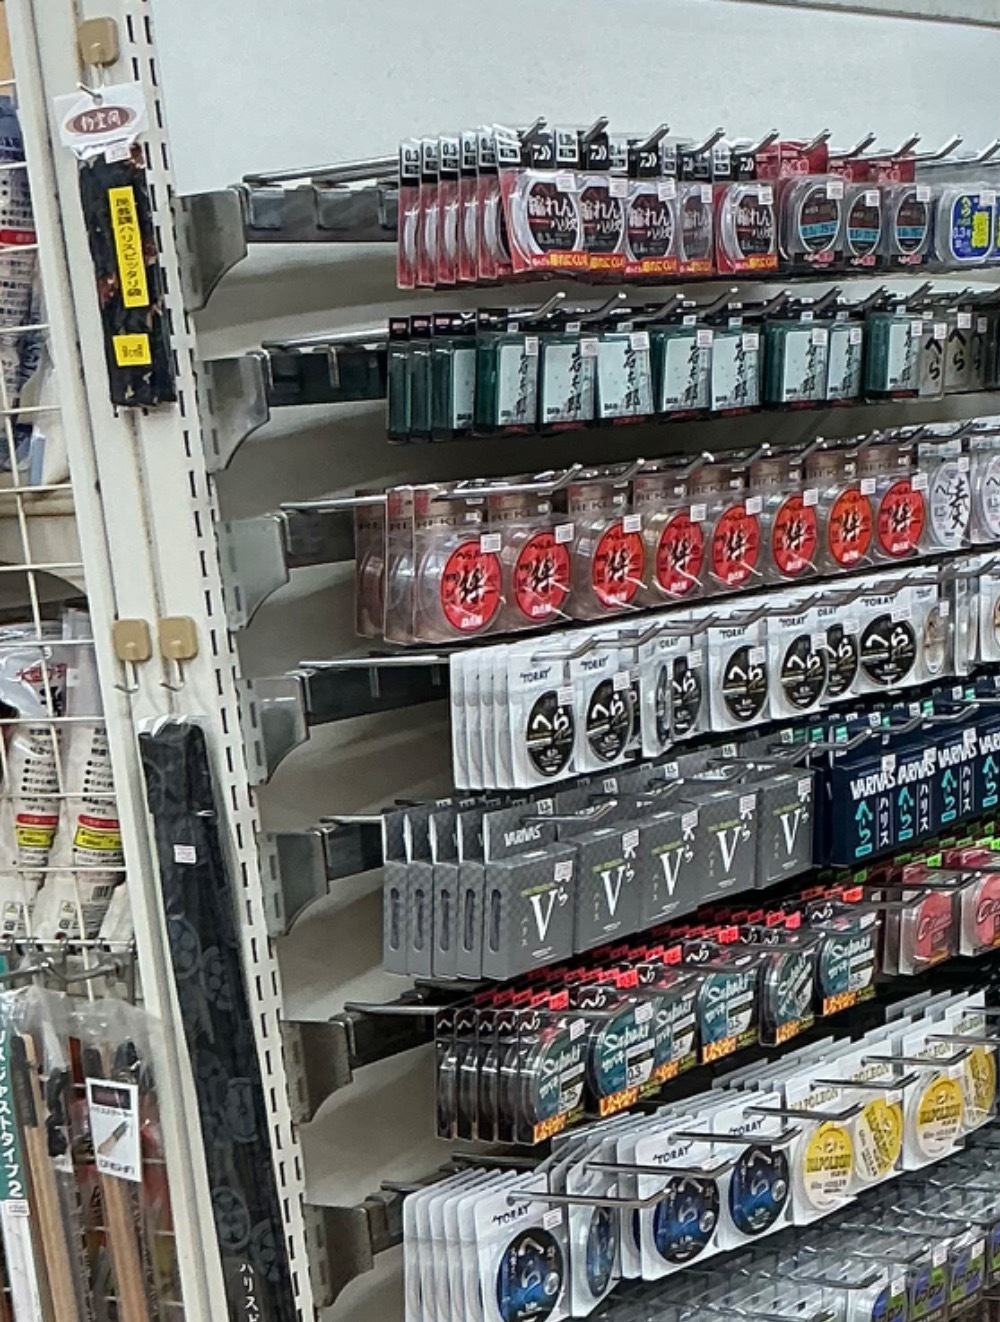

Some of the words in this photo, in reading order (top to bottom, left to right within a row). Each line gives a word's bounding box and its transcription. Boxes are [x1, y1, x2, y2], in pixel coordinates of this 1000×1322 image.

[925, 337, 943, 384] へら
[949, 328, 967, 372] へら
[860, 596, 896, 607] TORAY
[865, 627, 908, 648] へら
[728, 665, 763, 682] へら
[787, 653, 821, 670] へら
[532, 707, 571, 730] へら
[591, 693, 625, 719] へら
[941, 769, 957, 811] へら
[961, 765, 972, 812] ハリス
[982, 755, 999, 796] へら
[855, 800, 873, 845] へら
[878, 797, 890, 846] ハリス
[898, 787, 914, 829] へら
[919, 783, 930, 832] ハリス
[652, 1140, 695, 1164] TORAY
[491, 1200, 533, 1225] TORAY
